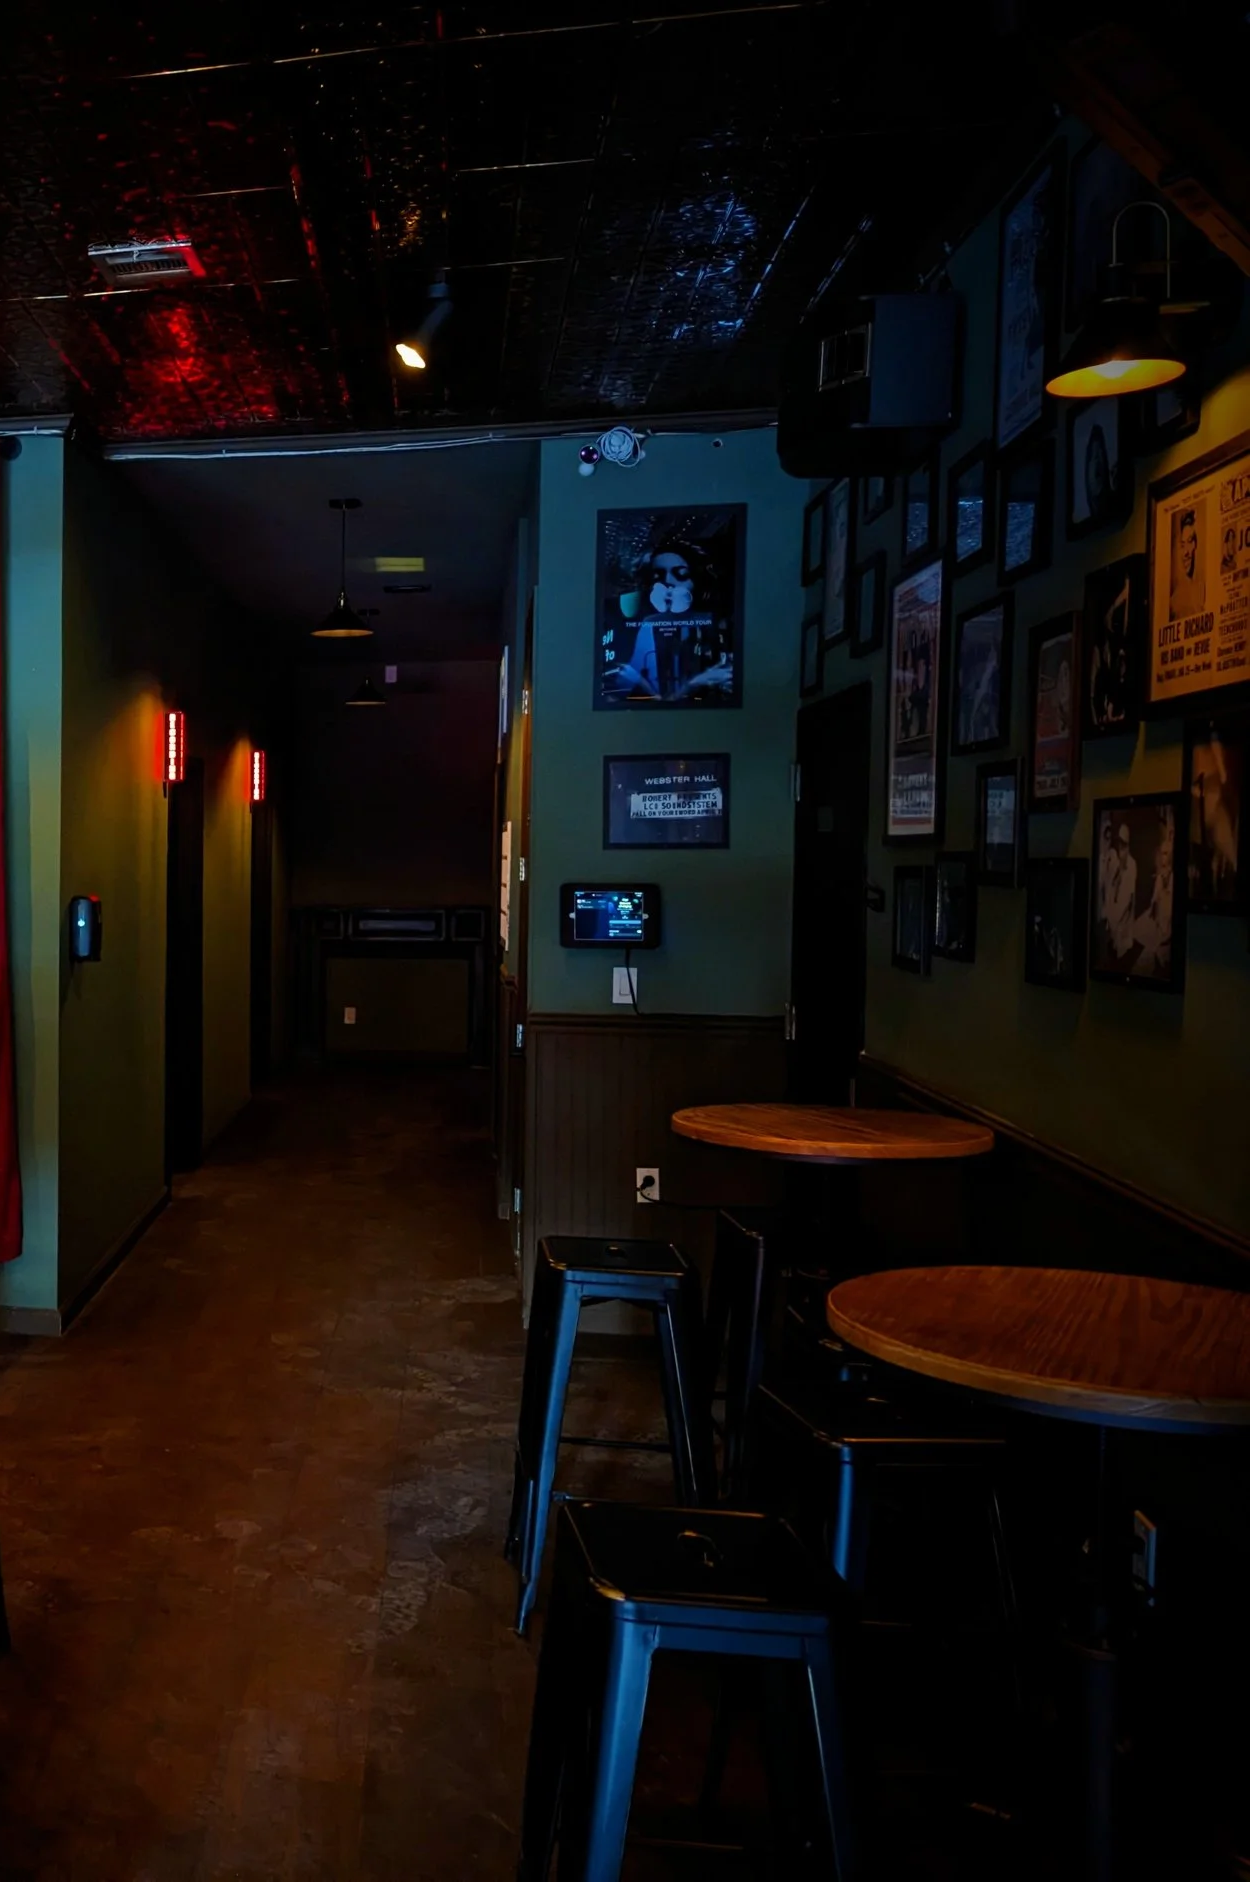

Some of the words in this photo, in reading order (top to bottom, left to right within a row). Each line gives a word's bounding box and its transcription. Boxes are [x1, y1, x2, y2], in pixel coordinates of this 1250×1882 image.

[1158, 622, 1181, 648] LITTLE
[1184, 611, 1215, 639] RICHARD
[644, 775, 690, 785] WEBSTER
[694, 774, 717, 783] HALL
